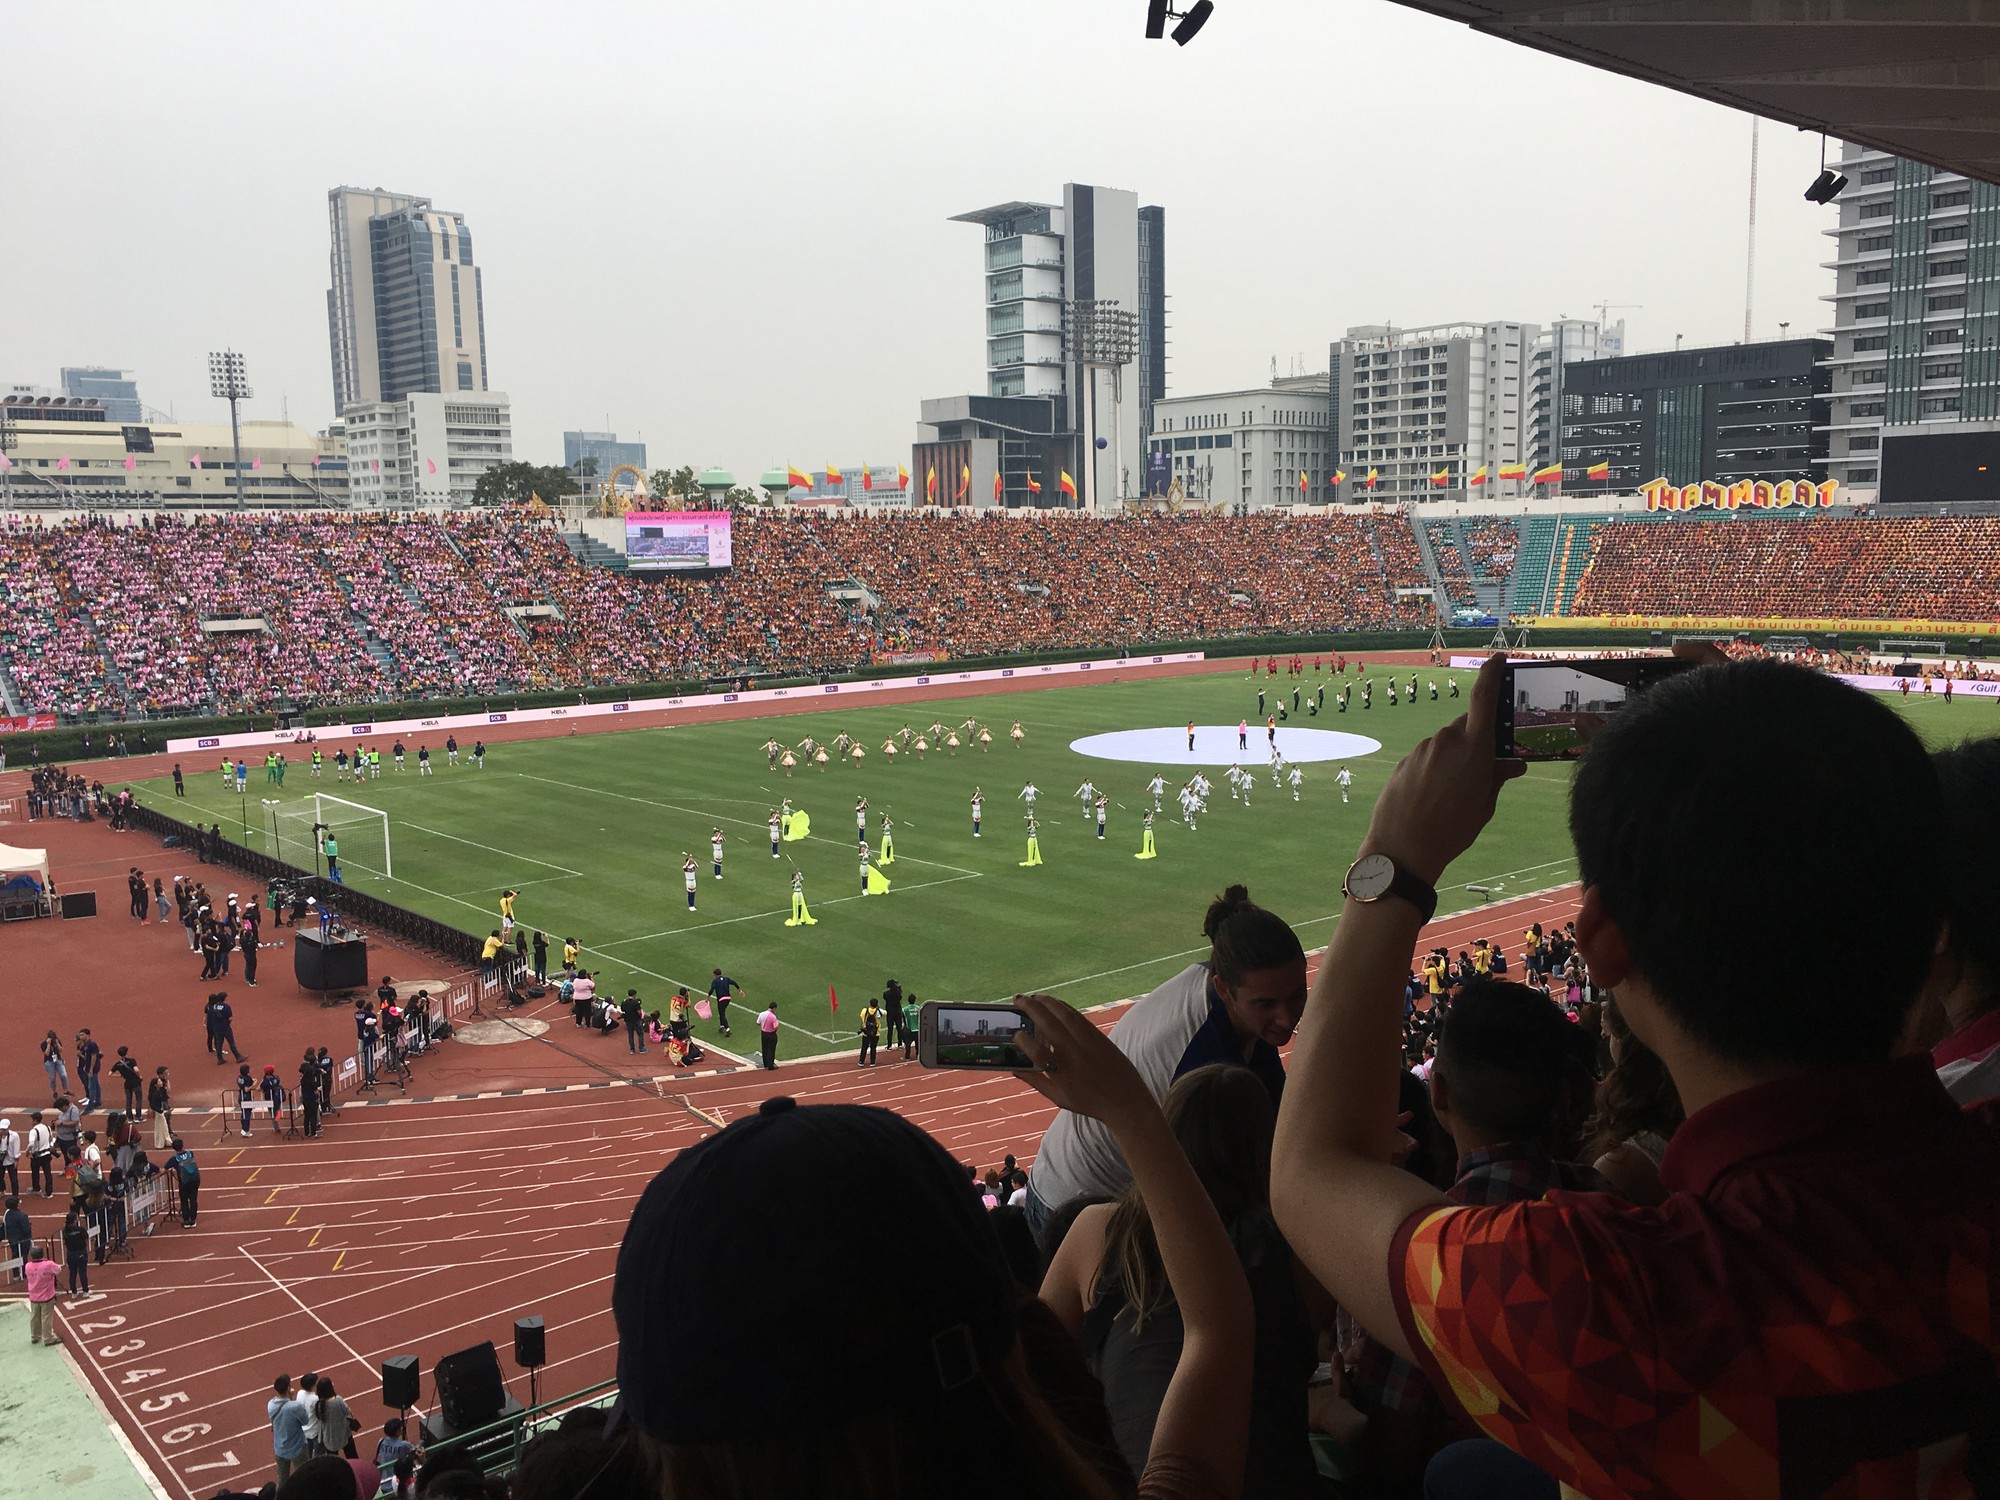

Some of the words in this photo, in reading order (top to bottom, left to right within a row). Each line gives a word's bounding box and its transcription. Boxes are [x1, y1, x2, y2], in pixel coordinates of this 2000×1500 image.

[1638, 477, 1839, 512] THAMMASAT
[1976, 683, 1998, 693] Gulf
[63, 1293, 107, 1310] 1
[80, 1315, 126, 1334] 2
[99, 1339, 146, 1357] 3
[121, 1368, 166, 1385] 4
[140, 1391, 190, 1412] 5
[162, 1423, 212, 1444] 6
[185, 1450, 241, 1474] 7
